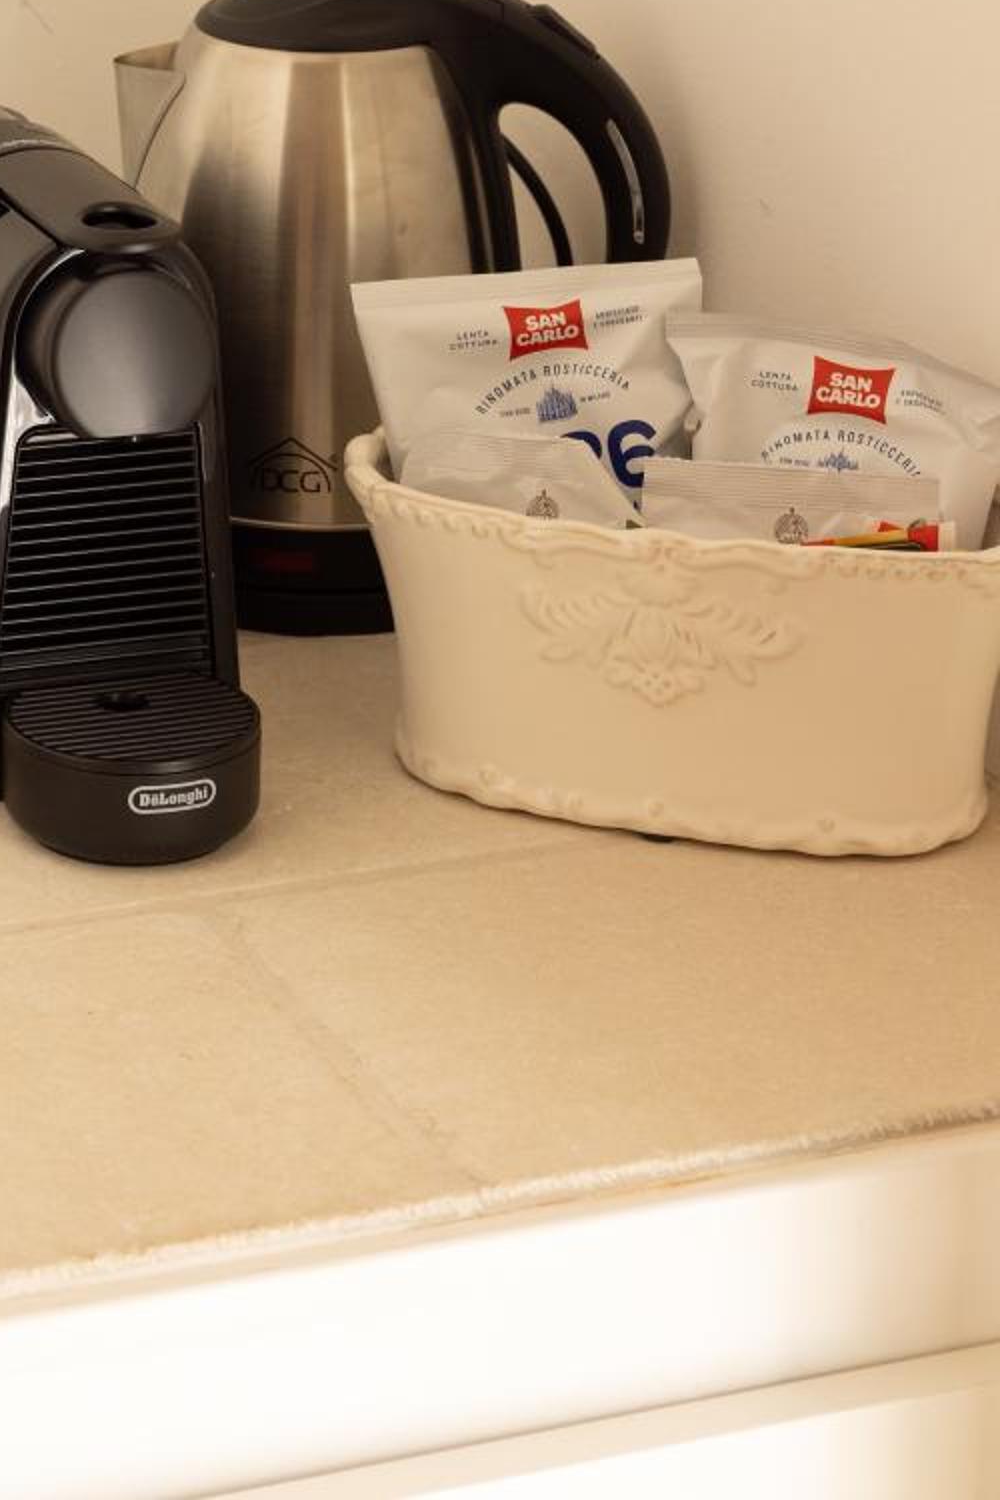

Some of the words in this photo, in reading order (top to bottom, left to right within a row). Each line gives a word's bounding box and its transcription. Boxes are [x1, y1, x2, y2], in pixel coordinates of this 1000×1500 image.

[524, 310, 567, 332] SAN
[515, 325, 580, 347] CARLO
[751, 380, 799, 391] COTTURA
[759, 371, 791, 381] LENTA
[828, 372, 873, 392] SAN
[474, 368, 538, 415] RINOMATA
[543, 363, 631, 391] ROSTICCERIA
[815, 387, 881, 411] CARLO
